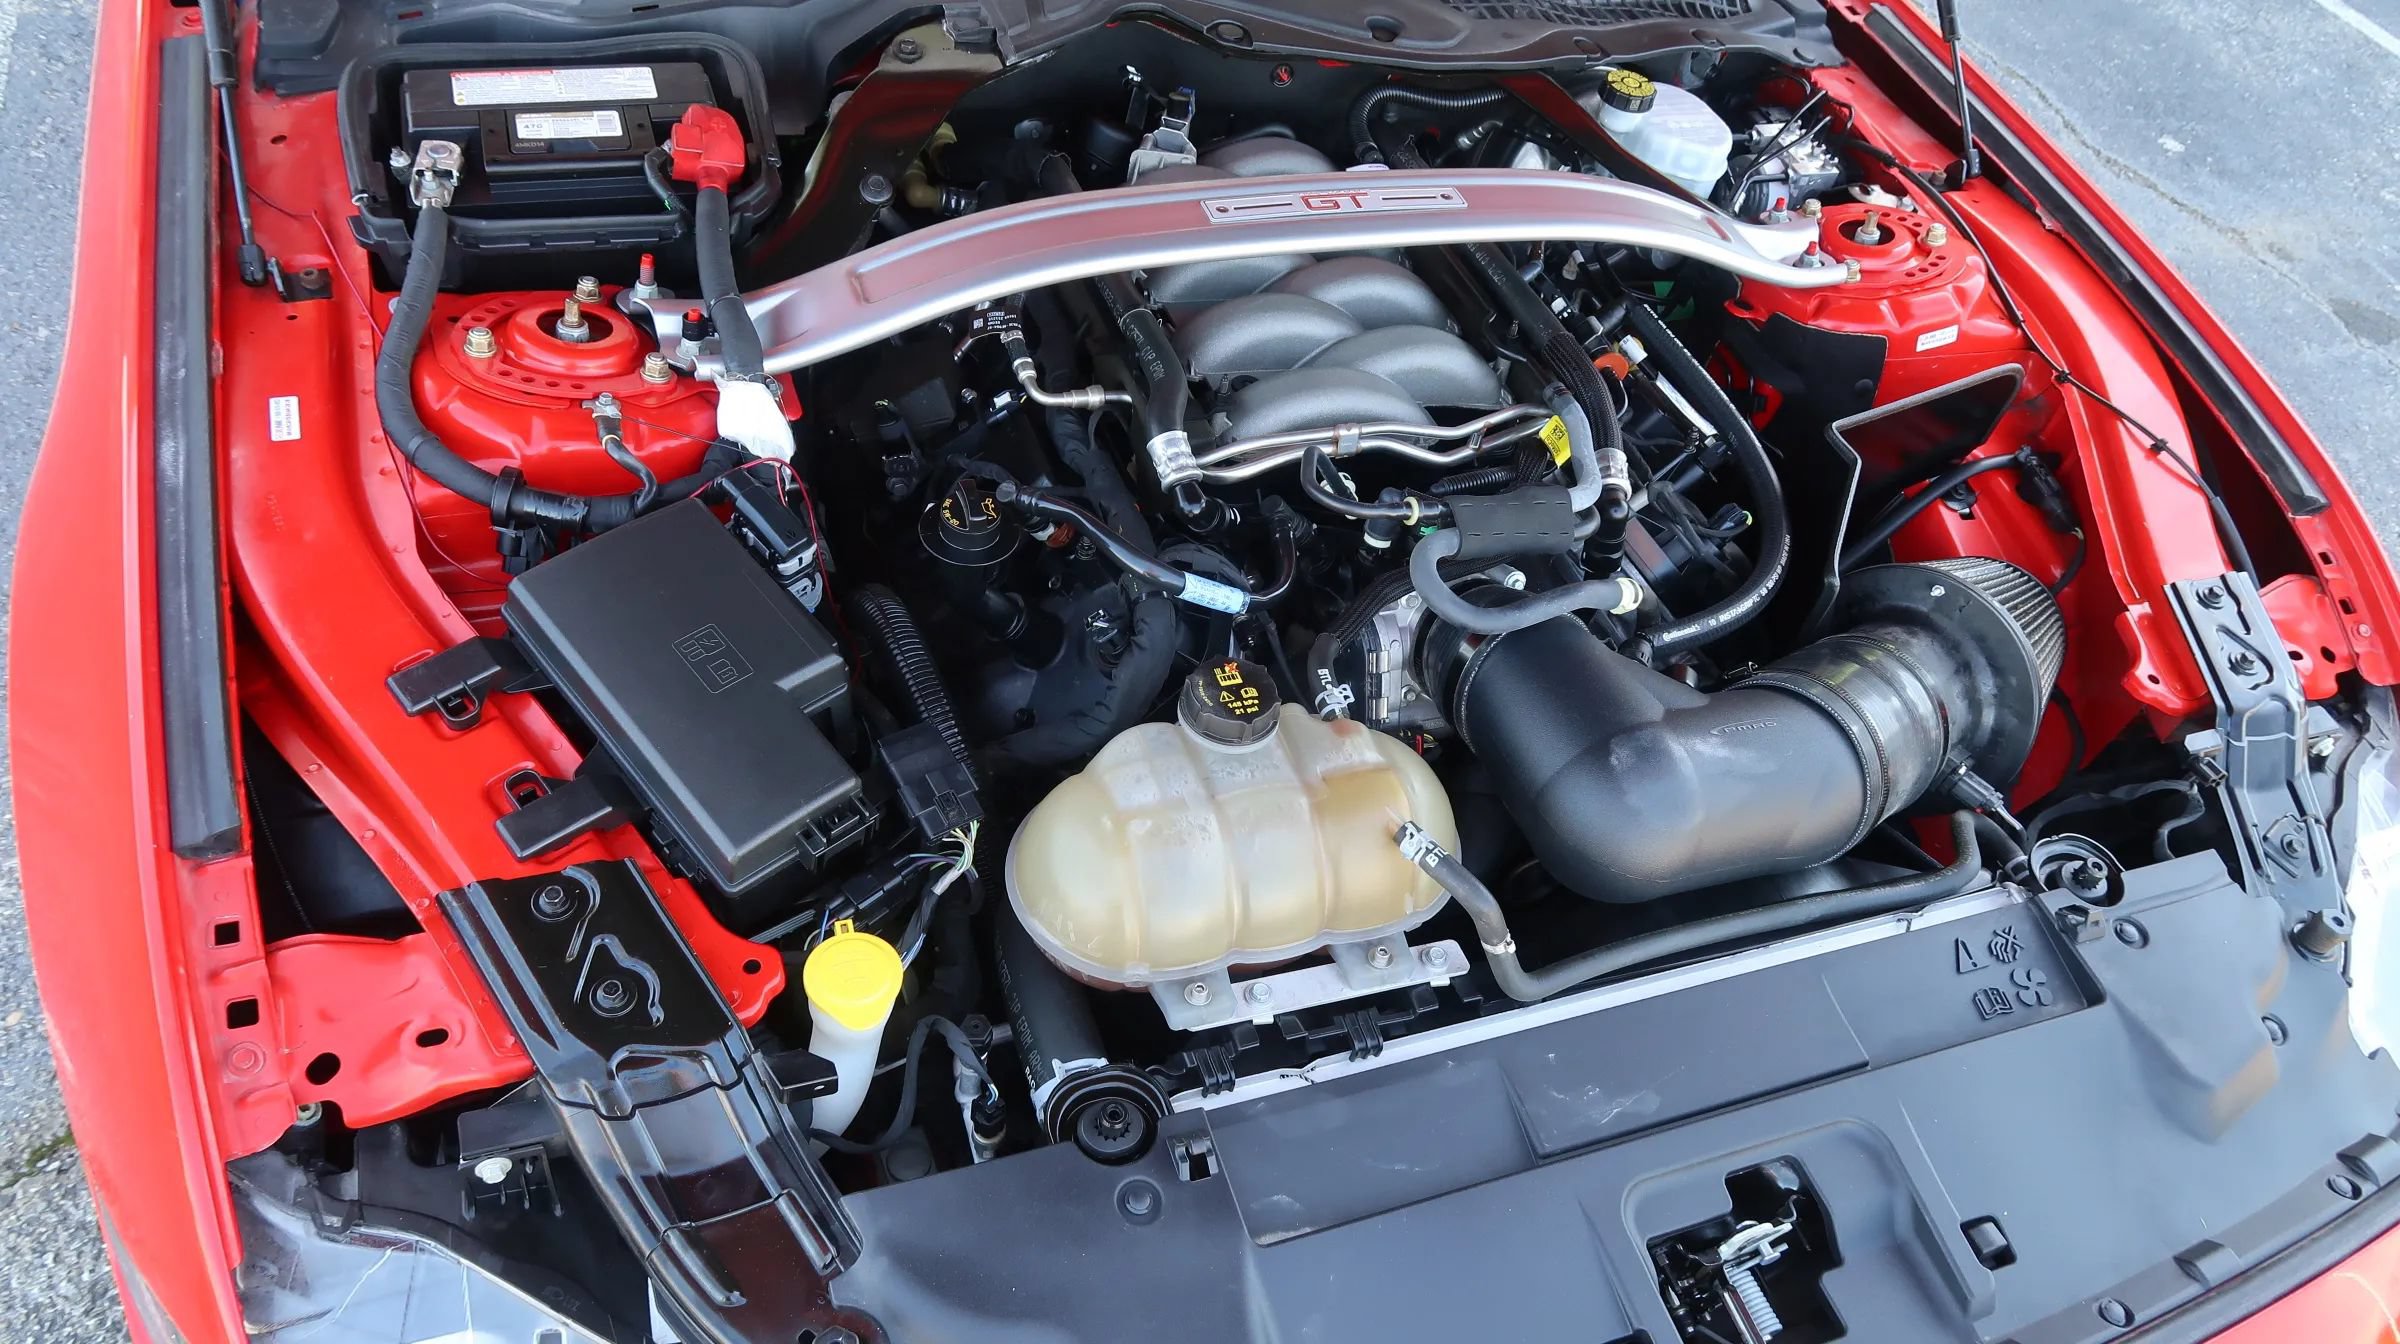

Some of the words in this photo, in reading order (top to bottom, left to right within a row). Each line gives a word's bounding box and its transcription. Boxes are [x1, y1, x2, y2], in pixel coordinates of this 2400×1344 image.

[1301, 191, 1368, 210] GT
[1317, 668, 1332, 686] BTL
[1425, 846, 1449, 868] BTL
